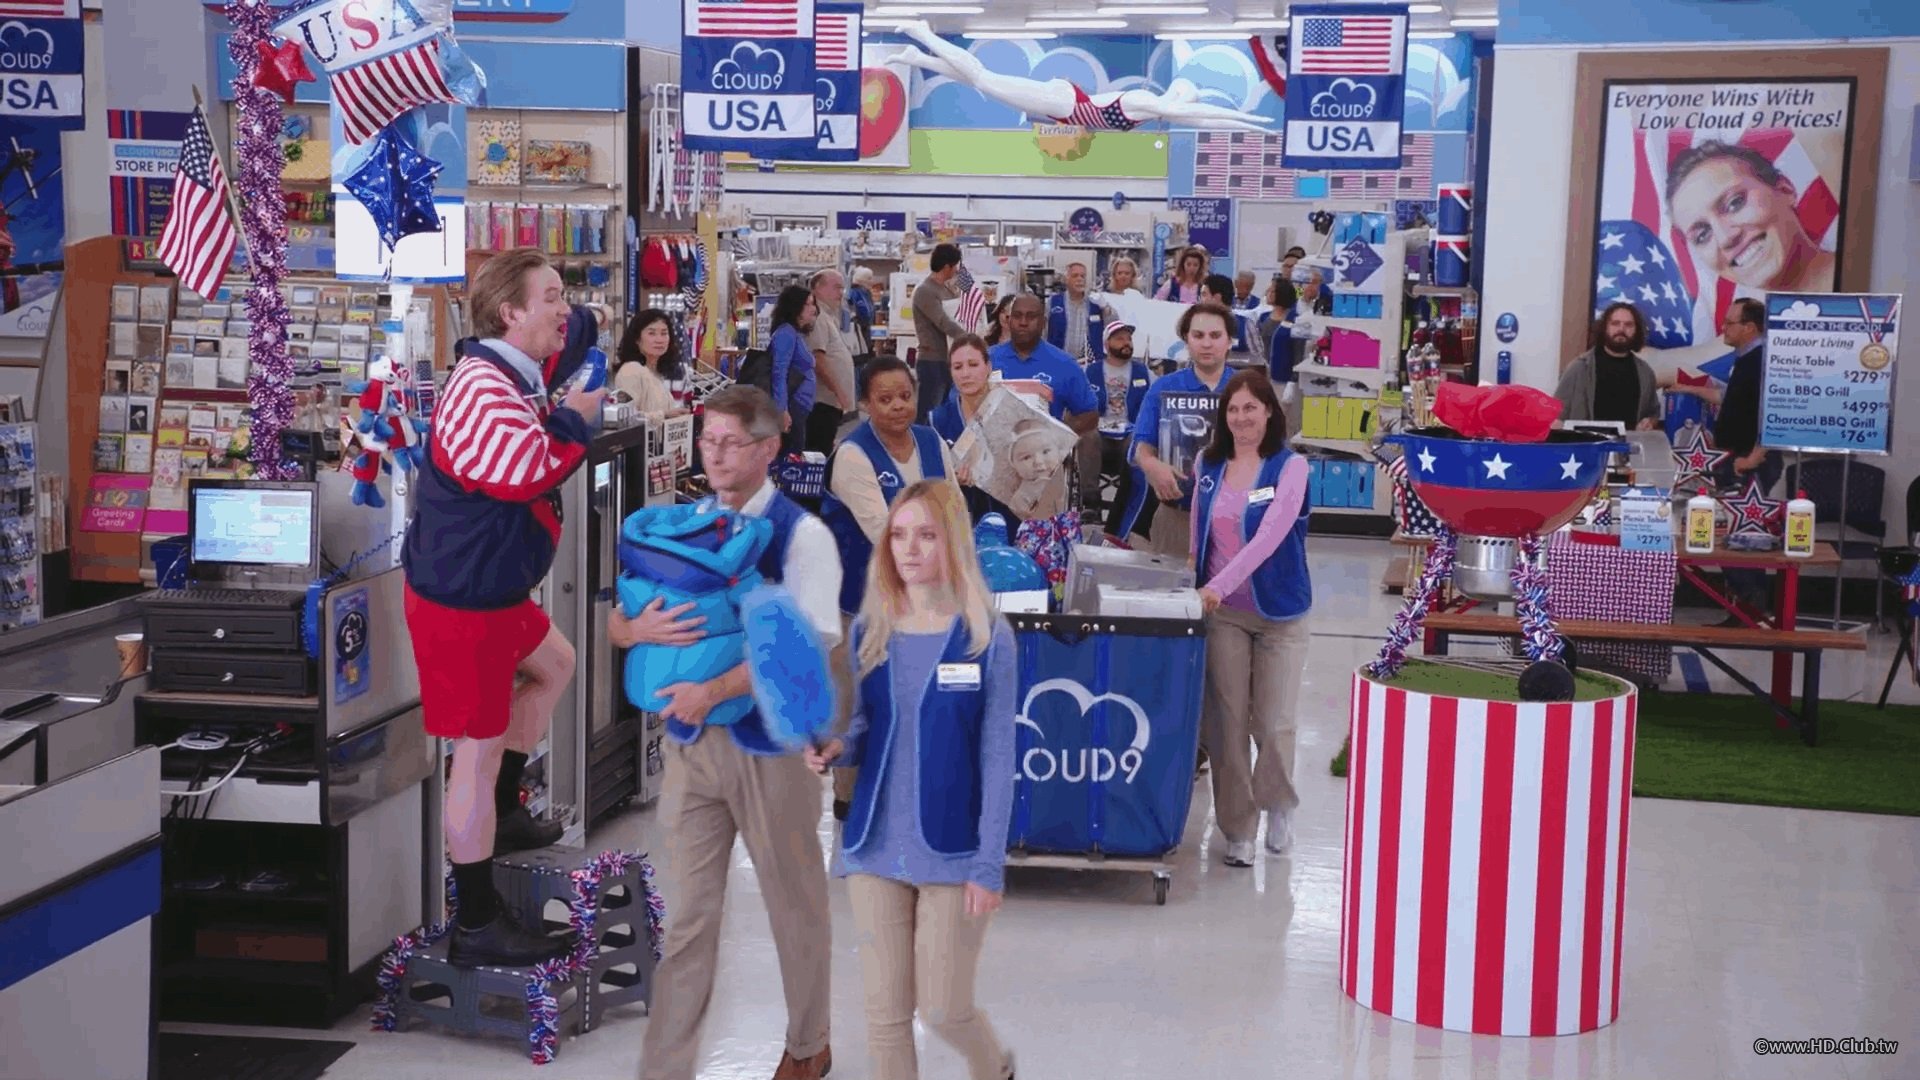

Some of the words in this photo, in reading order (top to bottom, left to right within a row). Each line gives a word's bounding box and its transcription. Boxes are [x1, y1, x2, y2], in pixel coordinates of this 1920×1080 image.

[711, 73, 783, 90] CLOUD9
[0, 79, 59, 110] SA
[1613, 91, 1705, 110] Everyone
[1712, 90, 1758, 106] Wins
[1767, 88, 1815, 106] With
[708, 100, 787, 132] USA
[1310, 103, 1374, 118] CLOUD9
[1638, 114, 1679, 130] Low
[1685, 112, 1744, 129] Cloud
[1752, 112, 1764, 129] 9
[1770, 110, 1842, 129] Prices!
[1307, 126, 1375, 152] USA
[115, 160, 154, 172] STORE
[1335, 250, 1364, 272] 5%
[1784, 321, 1803, 331] GO
[1806, 321, 1826, 332] FOR
[1829, 322, 1846, 332] THE
[1772, 336, 1817, 348] Outdoor
[1821, 336, 1855, 350] Living
[1770, 354, 1804, 365] Picnic
[1806, 355, 1836, 366] Table
[1768, 383, 1791, 395] Gas
[1795, 385, 1822, 397] BBQ
[1825, 386, 1850, 397] Grill
[1166, 397, 1219, 411] KEURI
[1766, 413, 1817, 426] Charcoal
[1820, 416, 1847, 427] BBQ
[1850, 417, 1876, 428] Grill
[92, 508, 136, 520] Greeting
[97, 517, 125, 527] Cards
